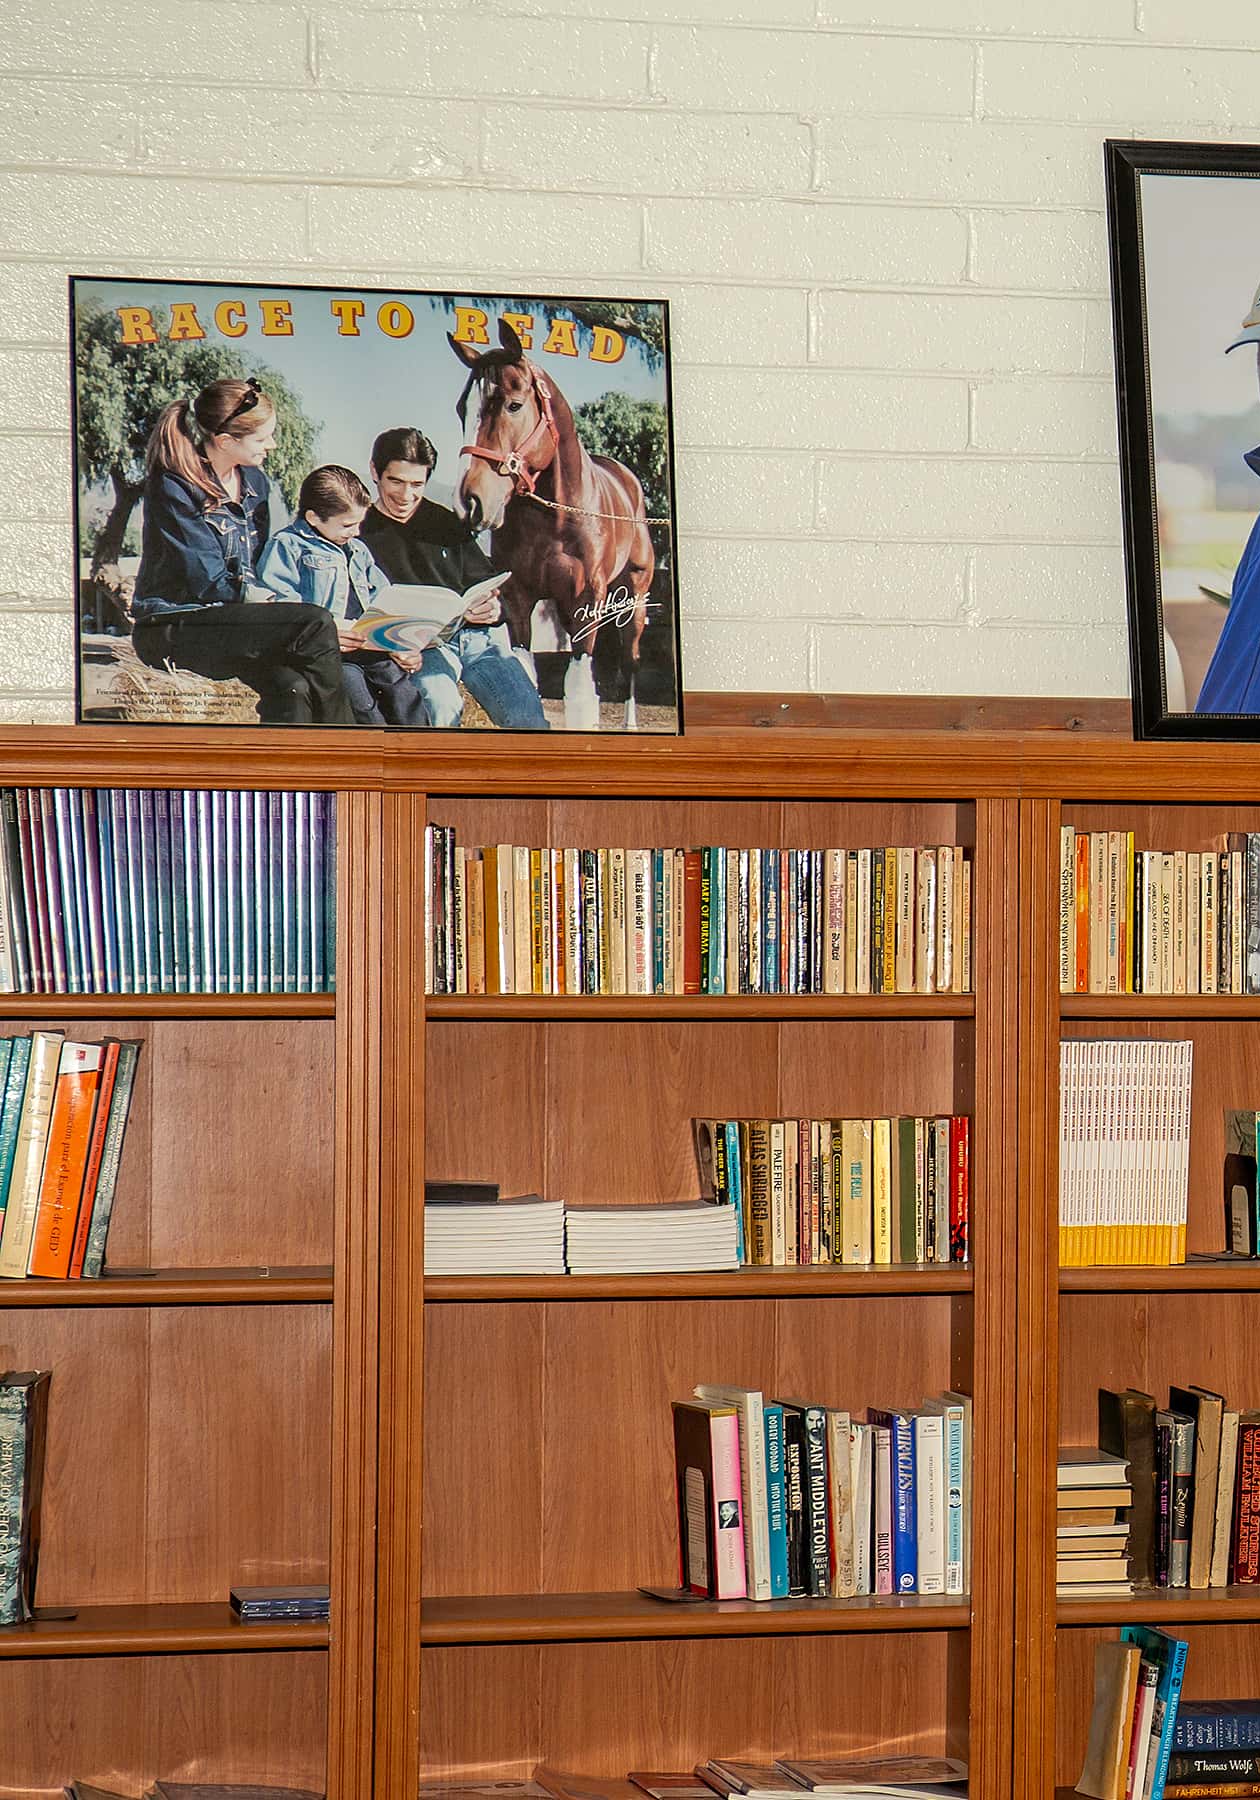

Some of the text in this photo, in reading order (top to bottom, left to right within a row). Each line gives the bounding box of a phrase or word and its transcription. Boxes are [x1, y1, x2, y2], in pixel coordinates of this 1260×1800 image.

[116, 299, 626, 364] RACE TO READ
[634, 872, 645, 930] GILES GOAT-BOY
[701, 878, 710, 954] HARP OF BURMA
[717, 1138, 726, 1190] THE DEER PARK
[750, 1129, 769, 1161] ATLAS
[773, 1148, 783, 1193] PALE FIRE
[751, 1163, 769, 1221] SHRUGGED
[850, 1161, 862, 1200] THE PEARL
[768, 1415, 782, 1531] ROBERT GODDARD INTO THE BLUE
[789, 1443, 801, 1512] EXPOSITION
[896, 1423, 913, 1492] MIRACLES
[949, 1422, 961, 1485] ENCHANTMENT
[810, 1444, 828, 1555] ANT MIDDLETON
[1238, 1428, 1253, 1565] WILLIAM FAULKNER
[877, 1532, 890, 1573] BULLSEYE
[1175, 1647, 1186, 1674] NINJA
[1164, 1692, 1179, 1750] BREAKTHROUGH
[1175, 1786, 1223, 1797] FAHRENHEIT
[1193, 1760, 1228, 1772] Thomas
[1228, 1759, 1253, 1775] Wolfe
